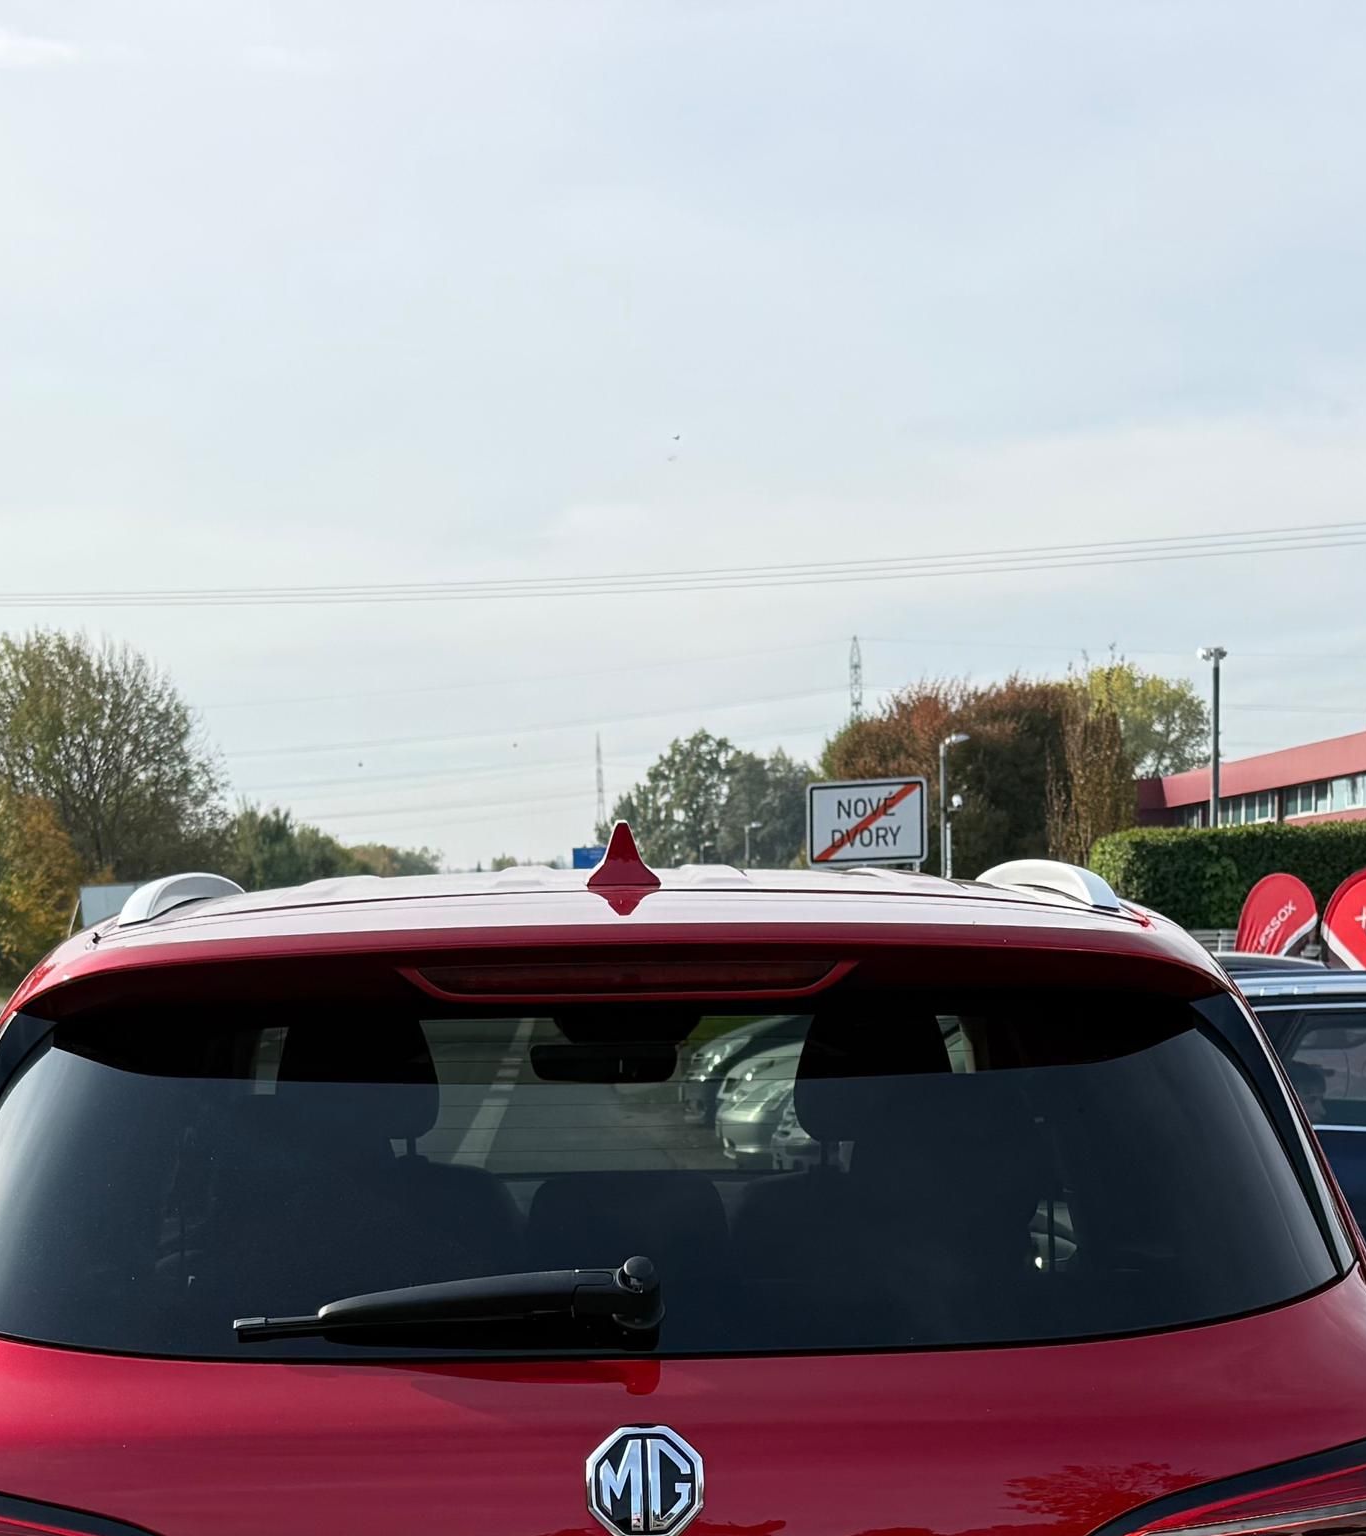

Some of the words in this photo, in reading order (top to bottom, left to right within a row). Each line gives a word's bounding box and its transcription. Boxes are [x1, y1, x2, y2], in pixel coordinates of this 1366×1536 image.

[837, 791, 896, 820] NOVÉ
[831, 825, 901, 848] DVORY
[599, 1438, 693, 1532] MG
